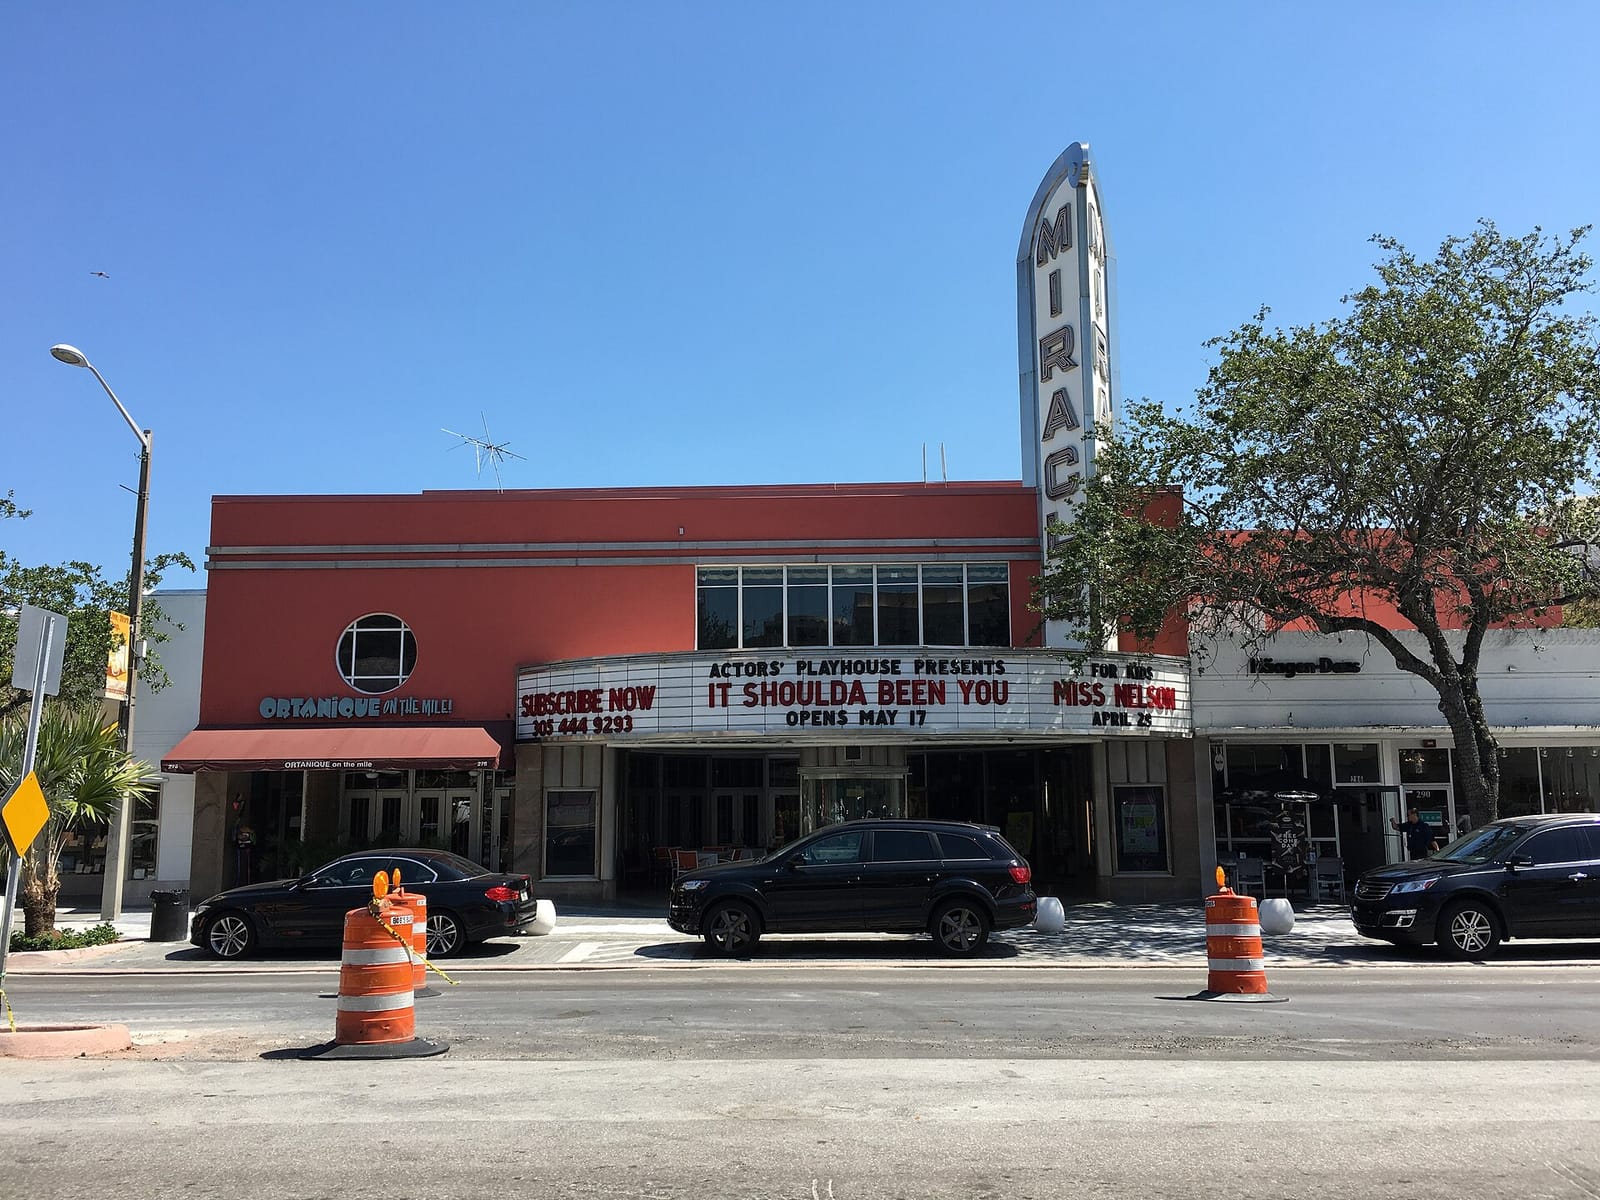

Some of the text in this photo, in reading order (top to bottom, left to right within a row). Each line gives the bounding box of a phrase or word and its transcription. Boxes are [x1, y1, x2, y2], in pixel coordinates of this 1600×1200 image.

[709, 659, 1006, 678] ACTORS' PLAYHOUSE PRESENTS
[1091, 662, 1154, 680] FOR KIDS
[521, 685, 656, 717] SUBSCRIBE NOW
[708, 679, 1009, 708] IT SHOULDA BEEN YOU
[1053, 681, 1176, 710] MISS NELSON
[383, 697, 398, 714] ON
[399, 696, 420, 716] THE
[532, 715, 633, 736] 305 444 9293
[786, 709, 926, 727] OPENS MAY 17
[1092, 711, 1132, 726] APRIL
[1416, 790, 1431, 798] 290
